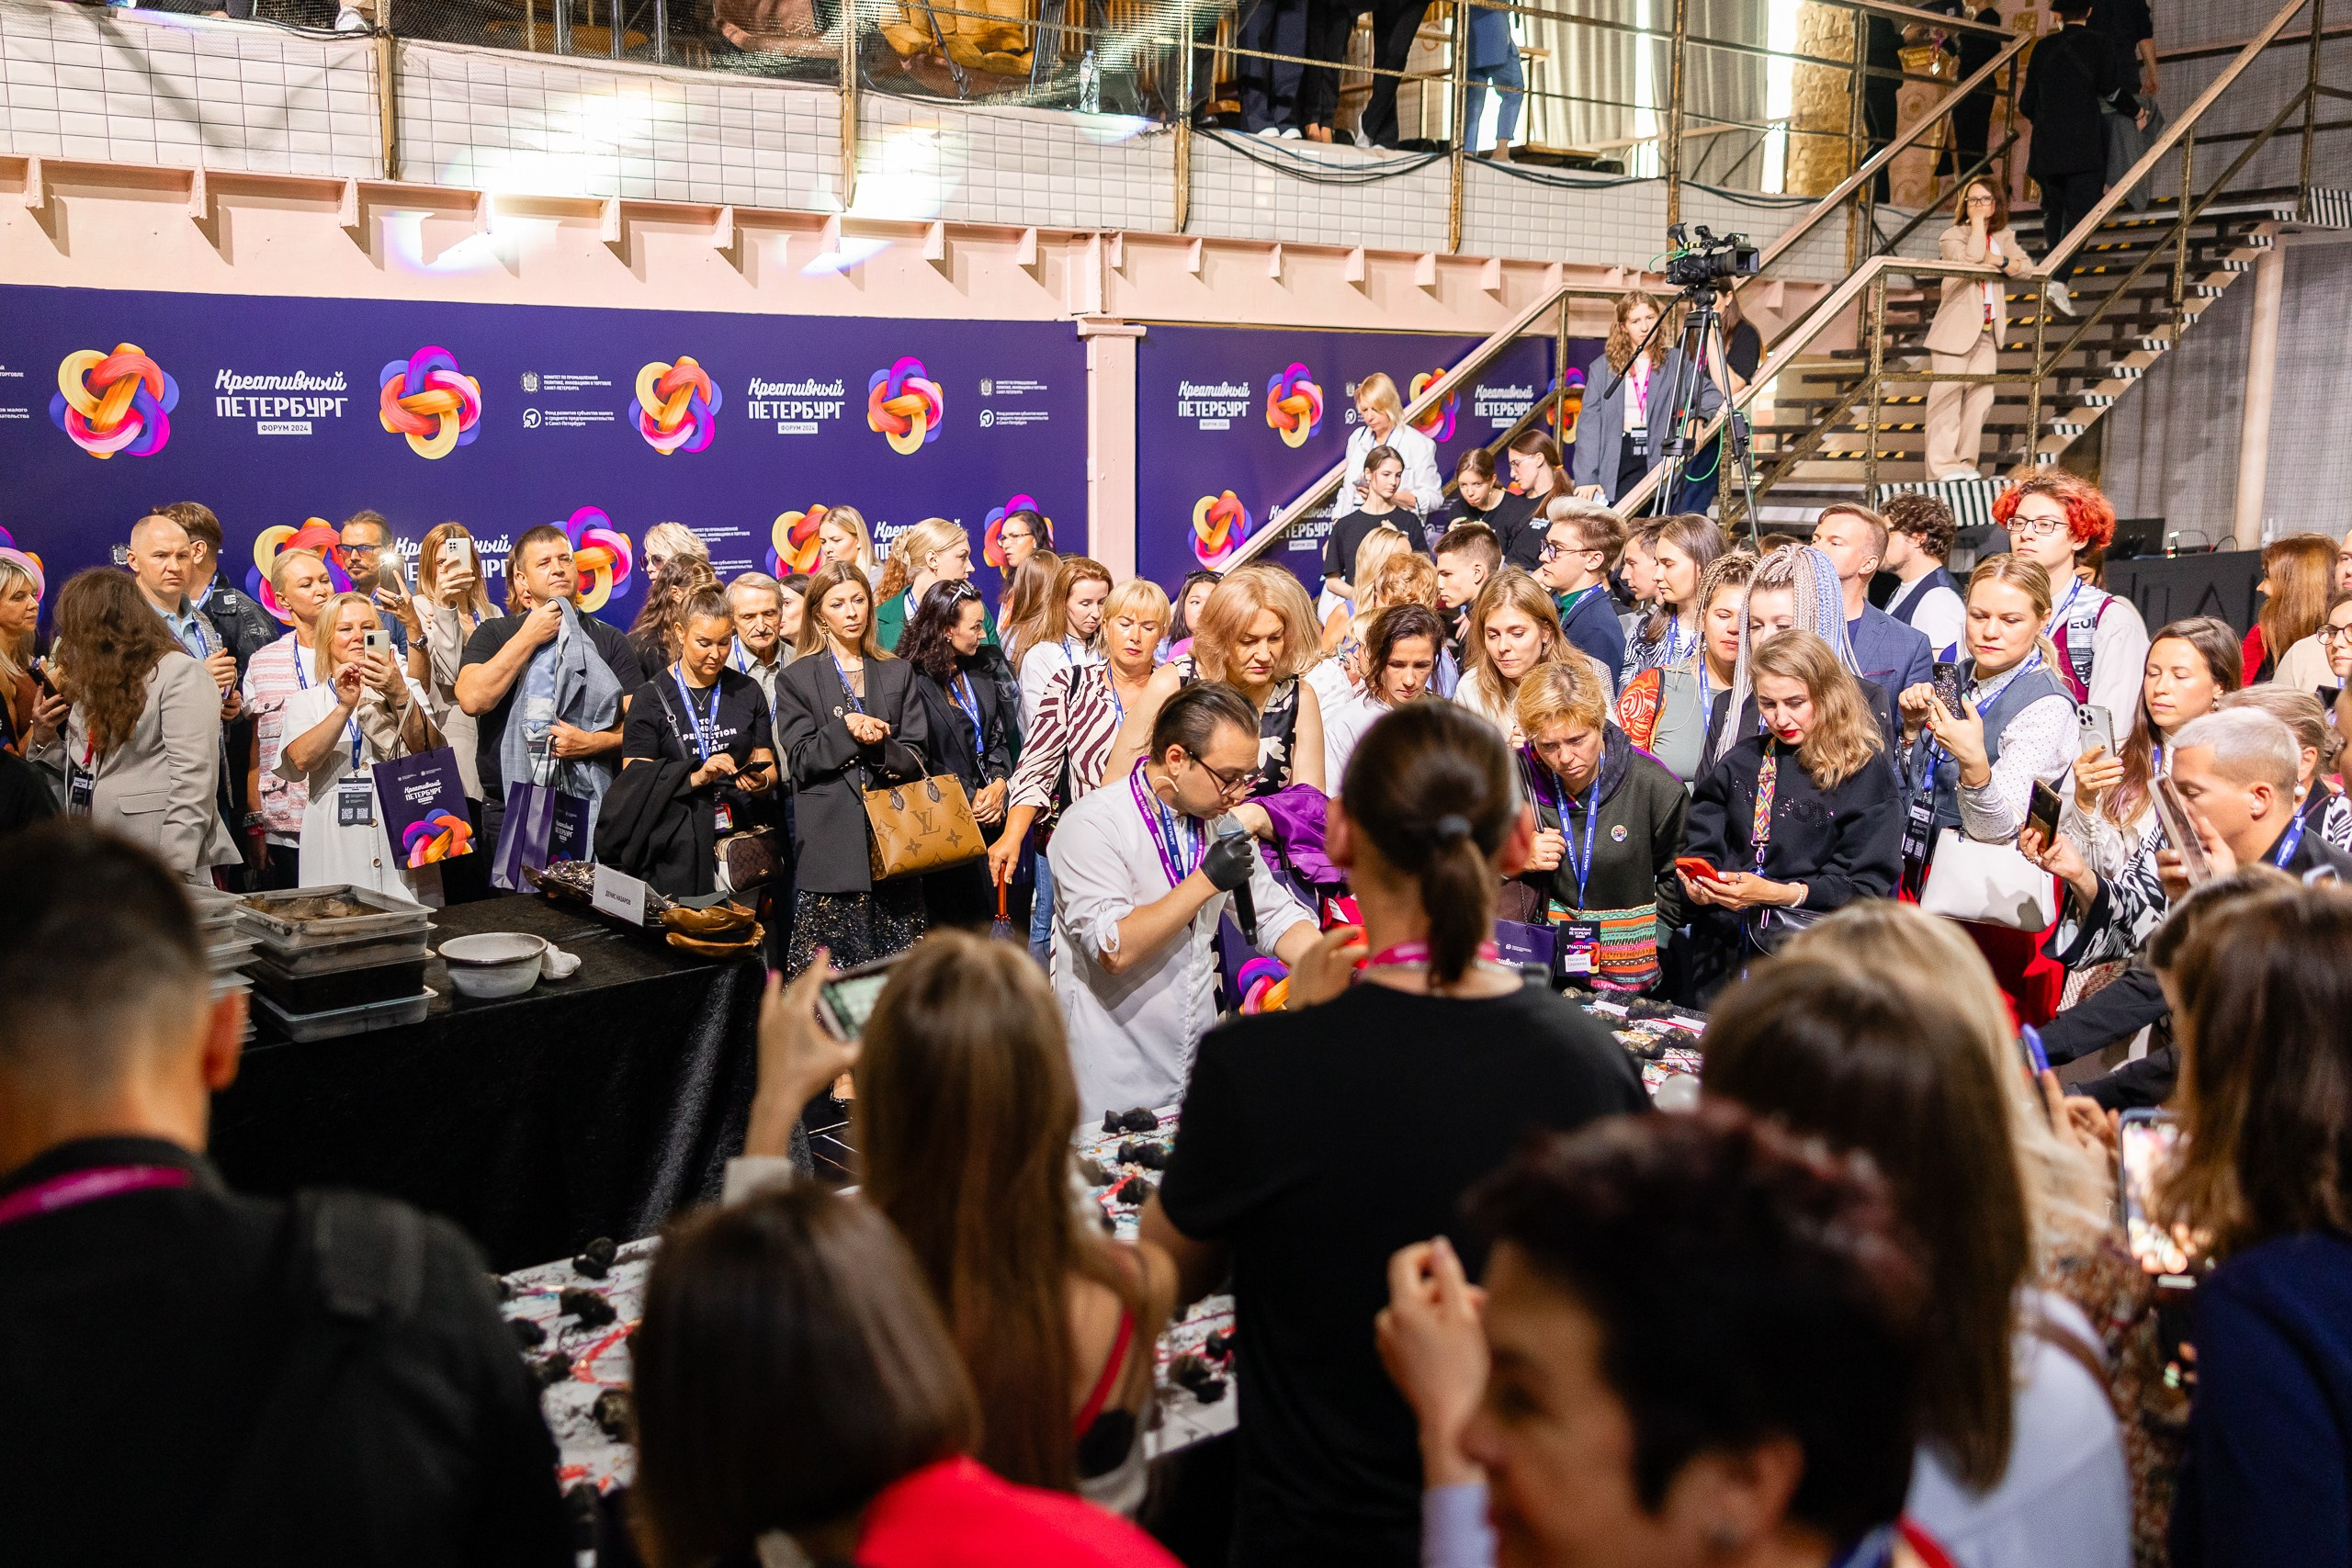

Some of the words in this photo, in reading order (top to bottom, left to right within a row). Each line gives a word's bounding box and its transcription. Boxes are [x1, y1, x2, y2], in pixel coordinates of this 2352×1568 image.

[214, 368, 348, 395] Креативный
[748, 378, 845, 400] Креативный
[1178, 380, 1250, 400] Креативный
[1475, 384, 1534, 401] Креативный
[216, 396, 348, 418] ПЕТЕРБУРГ
[748, 401, 845, 419] ПЕТЕРБУРГ
[1178, 400, 1250, 417] ПЕТЕРБУРГ
[1475, 401, 1534, 417] ПЕТЕРБУРГ
[405, 786, 442, 801] ПЕТЕРБУРГ
